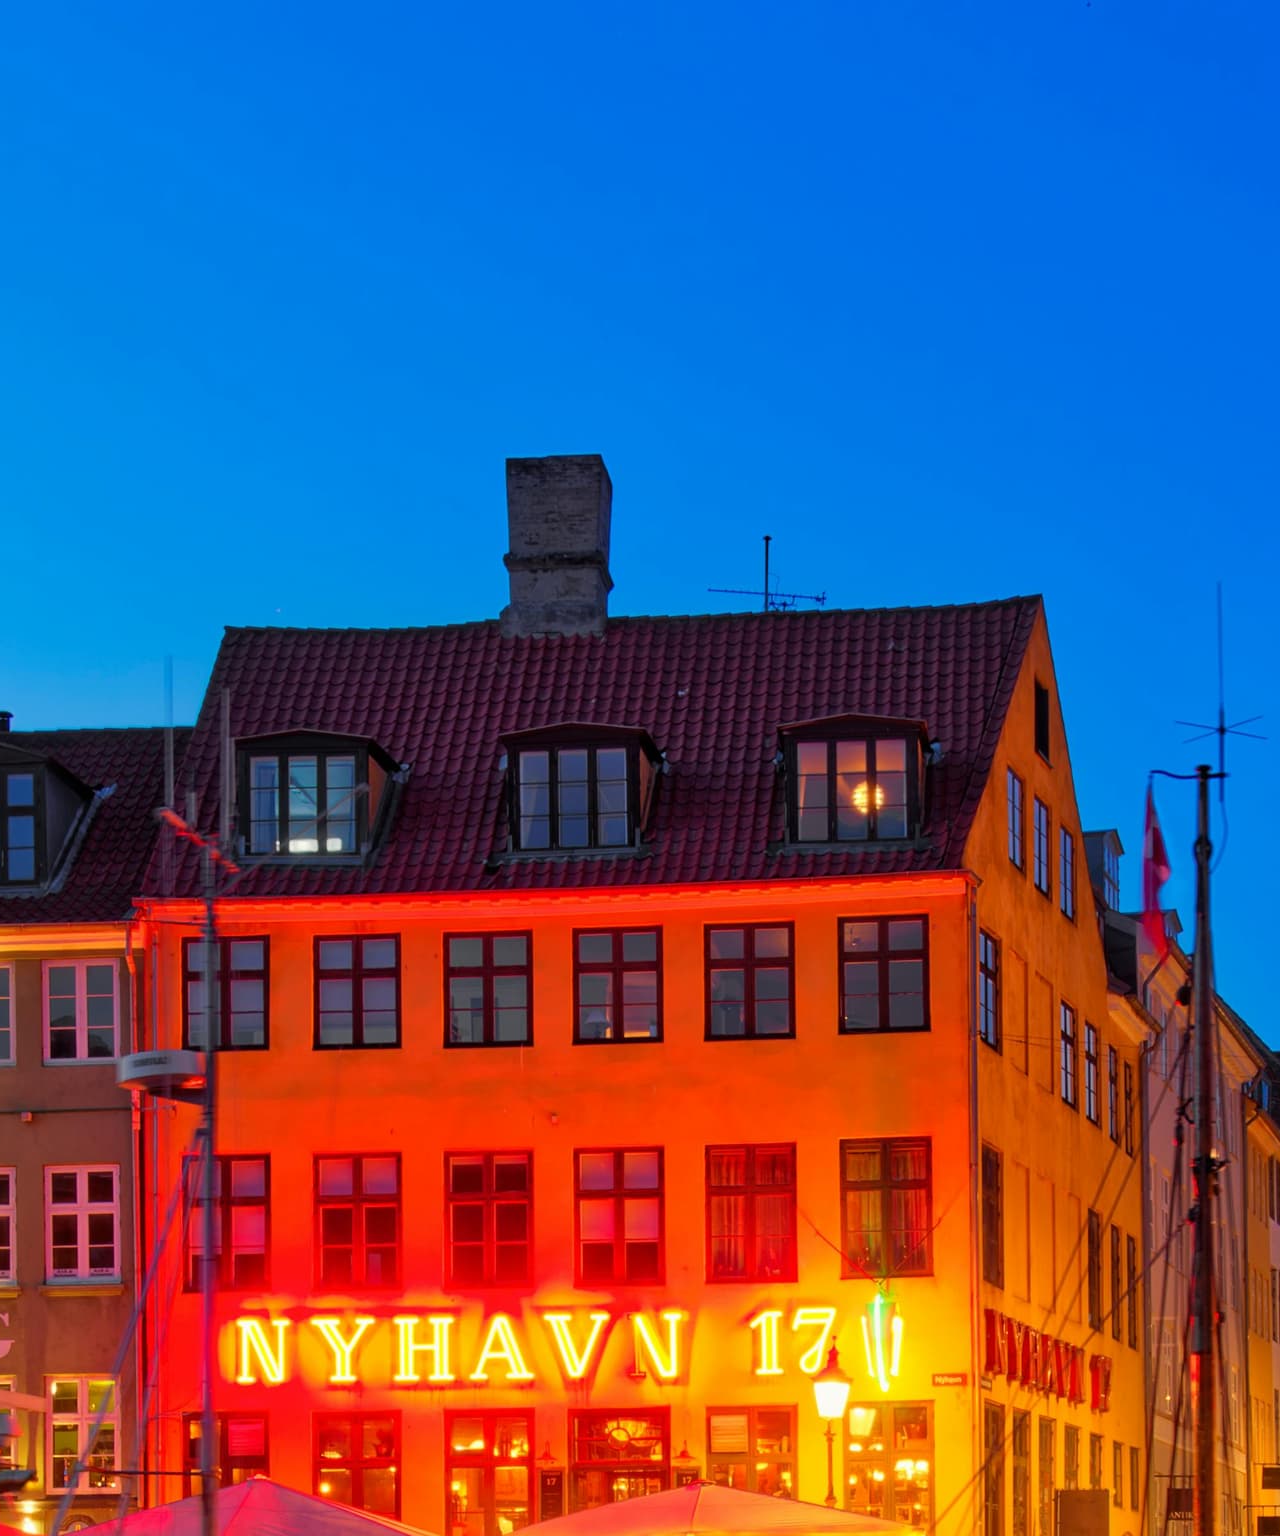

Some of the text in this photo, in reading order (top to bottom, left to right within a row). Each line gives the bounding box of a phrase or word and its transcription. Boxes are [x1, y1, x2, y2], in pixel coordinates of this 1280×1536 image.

[235, 1307, 837, 1384] NYHAVN 17
[984, 1308, 1086, 1405] NYHAVN
